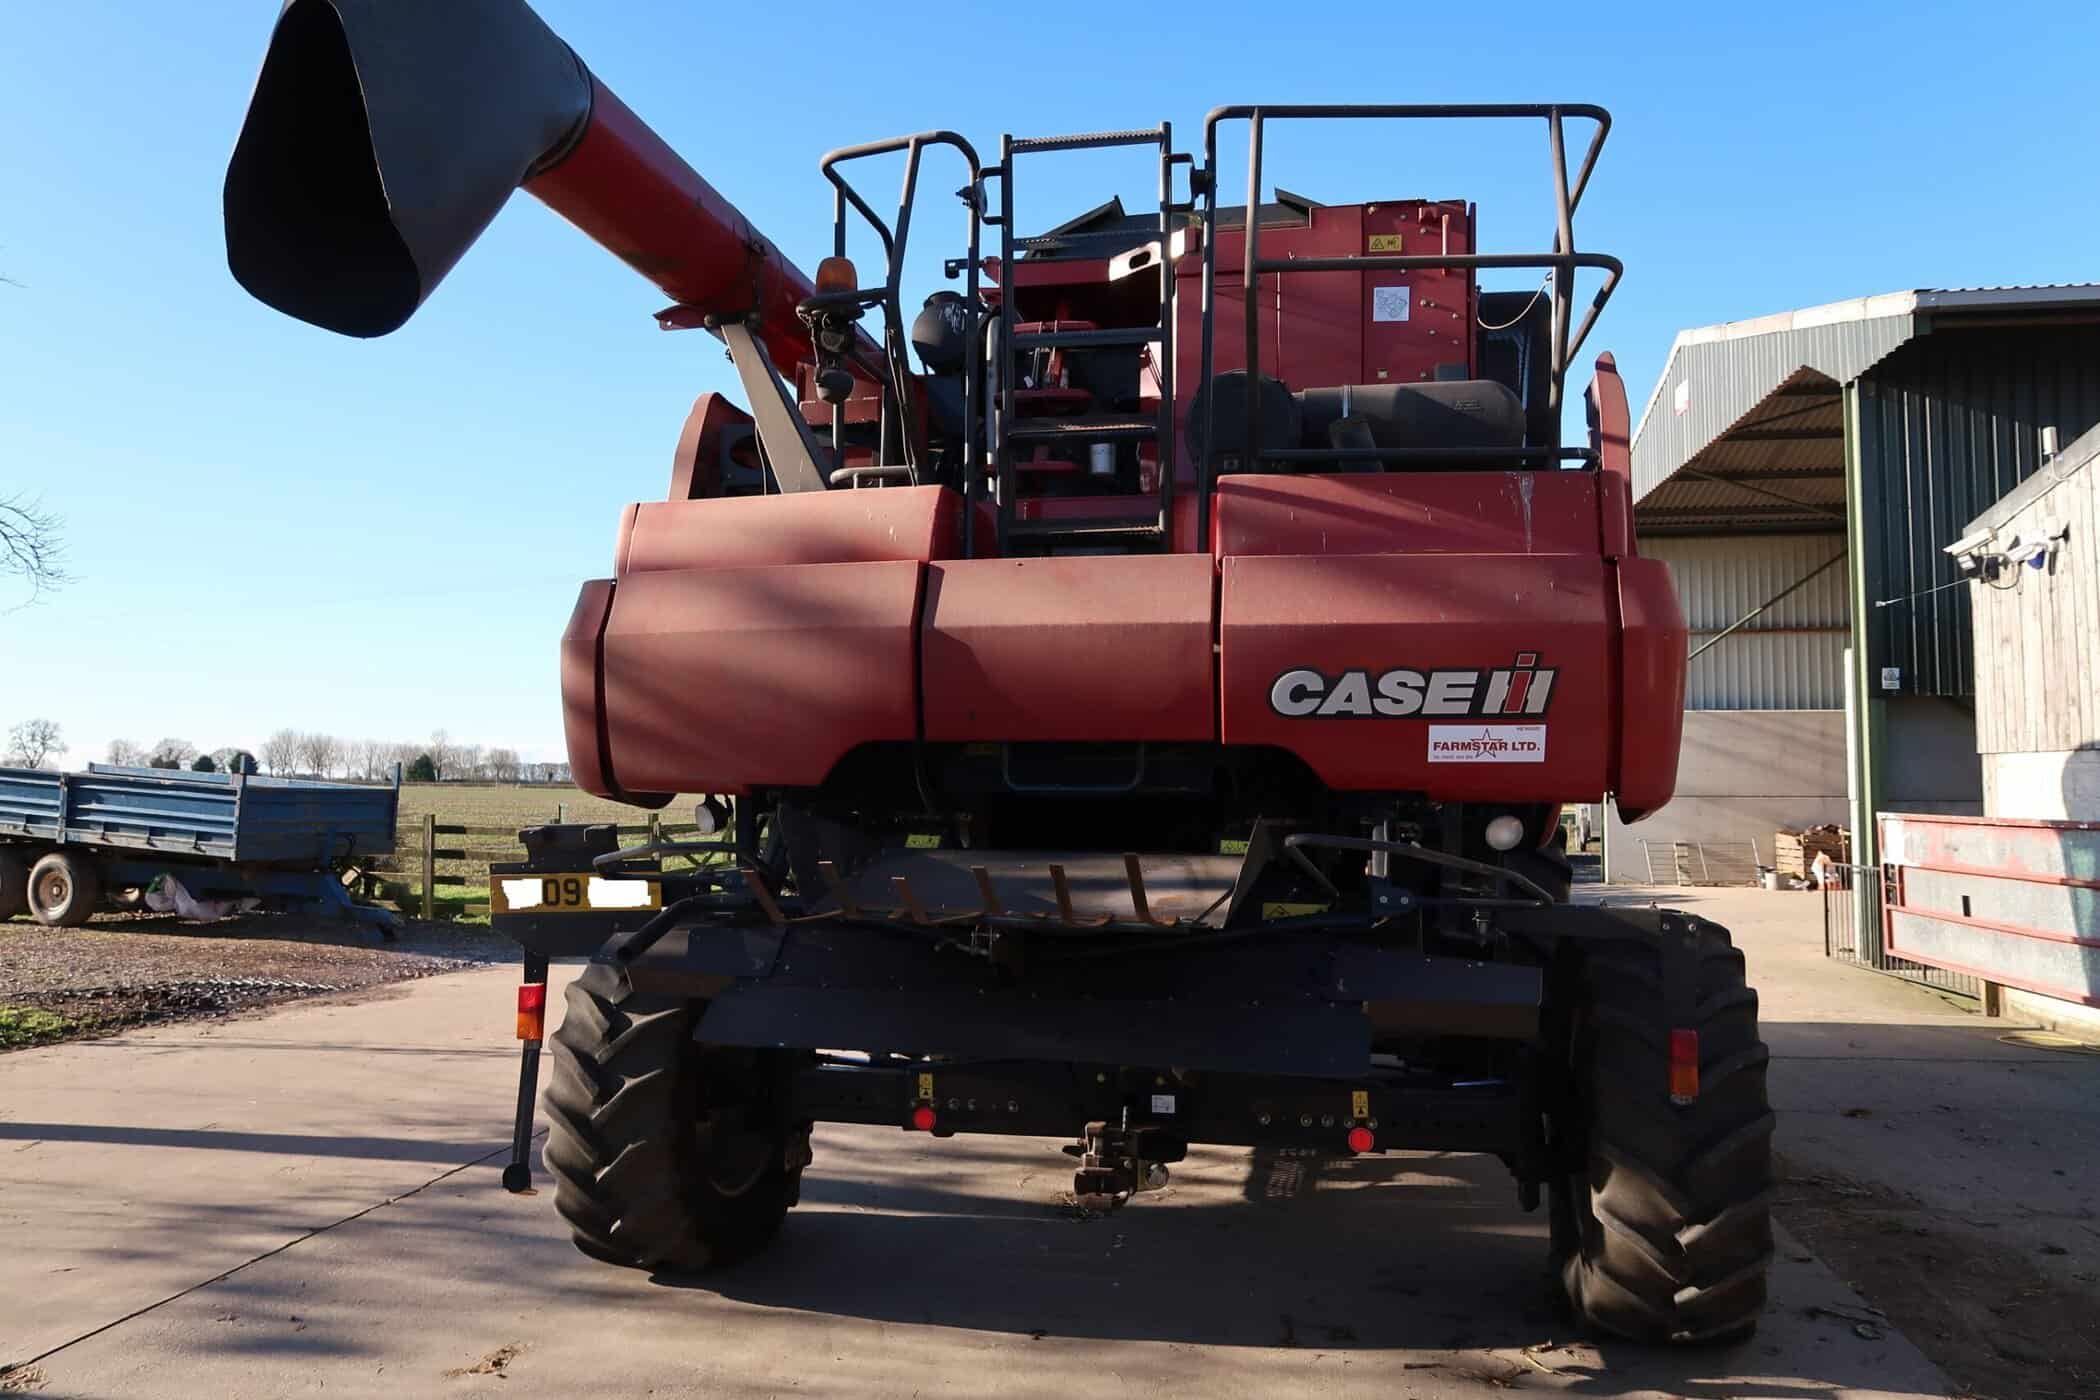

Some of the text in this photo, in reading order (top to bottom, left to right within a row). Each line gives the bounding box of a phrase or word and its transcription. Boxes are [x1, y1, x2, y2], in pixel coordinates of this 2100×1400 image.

[1271, 669, 1479, 715] CASE
[1432, 741, 1541, 752] FARMSTAR LTD.
